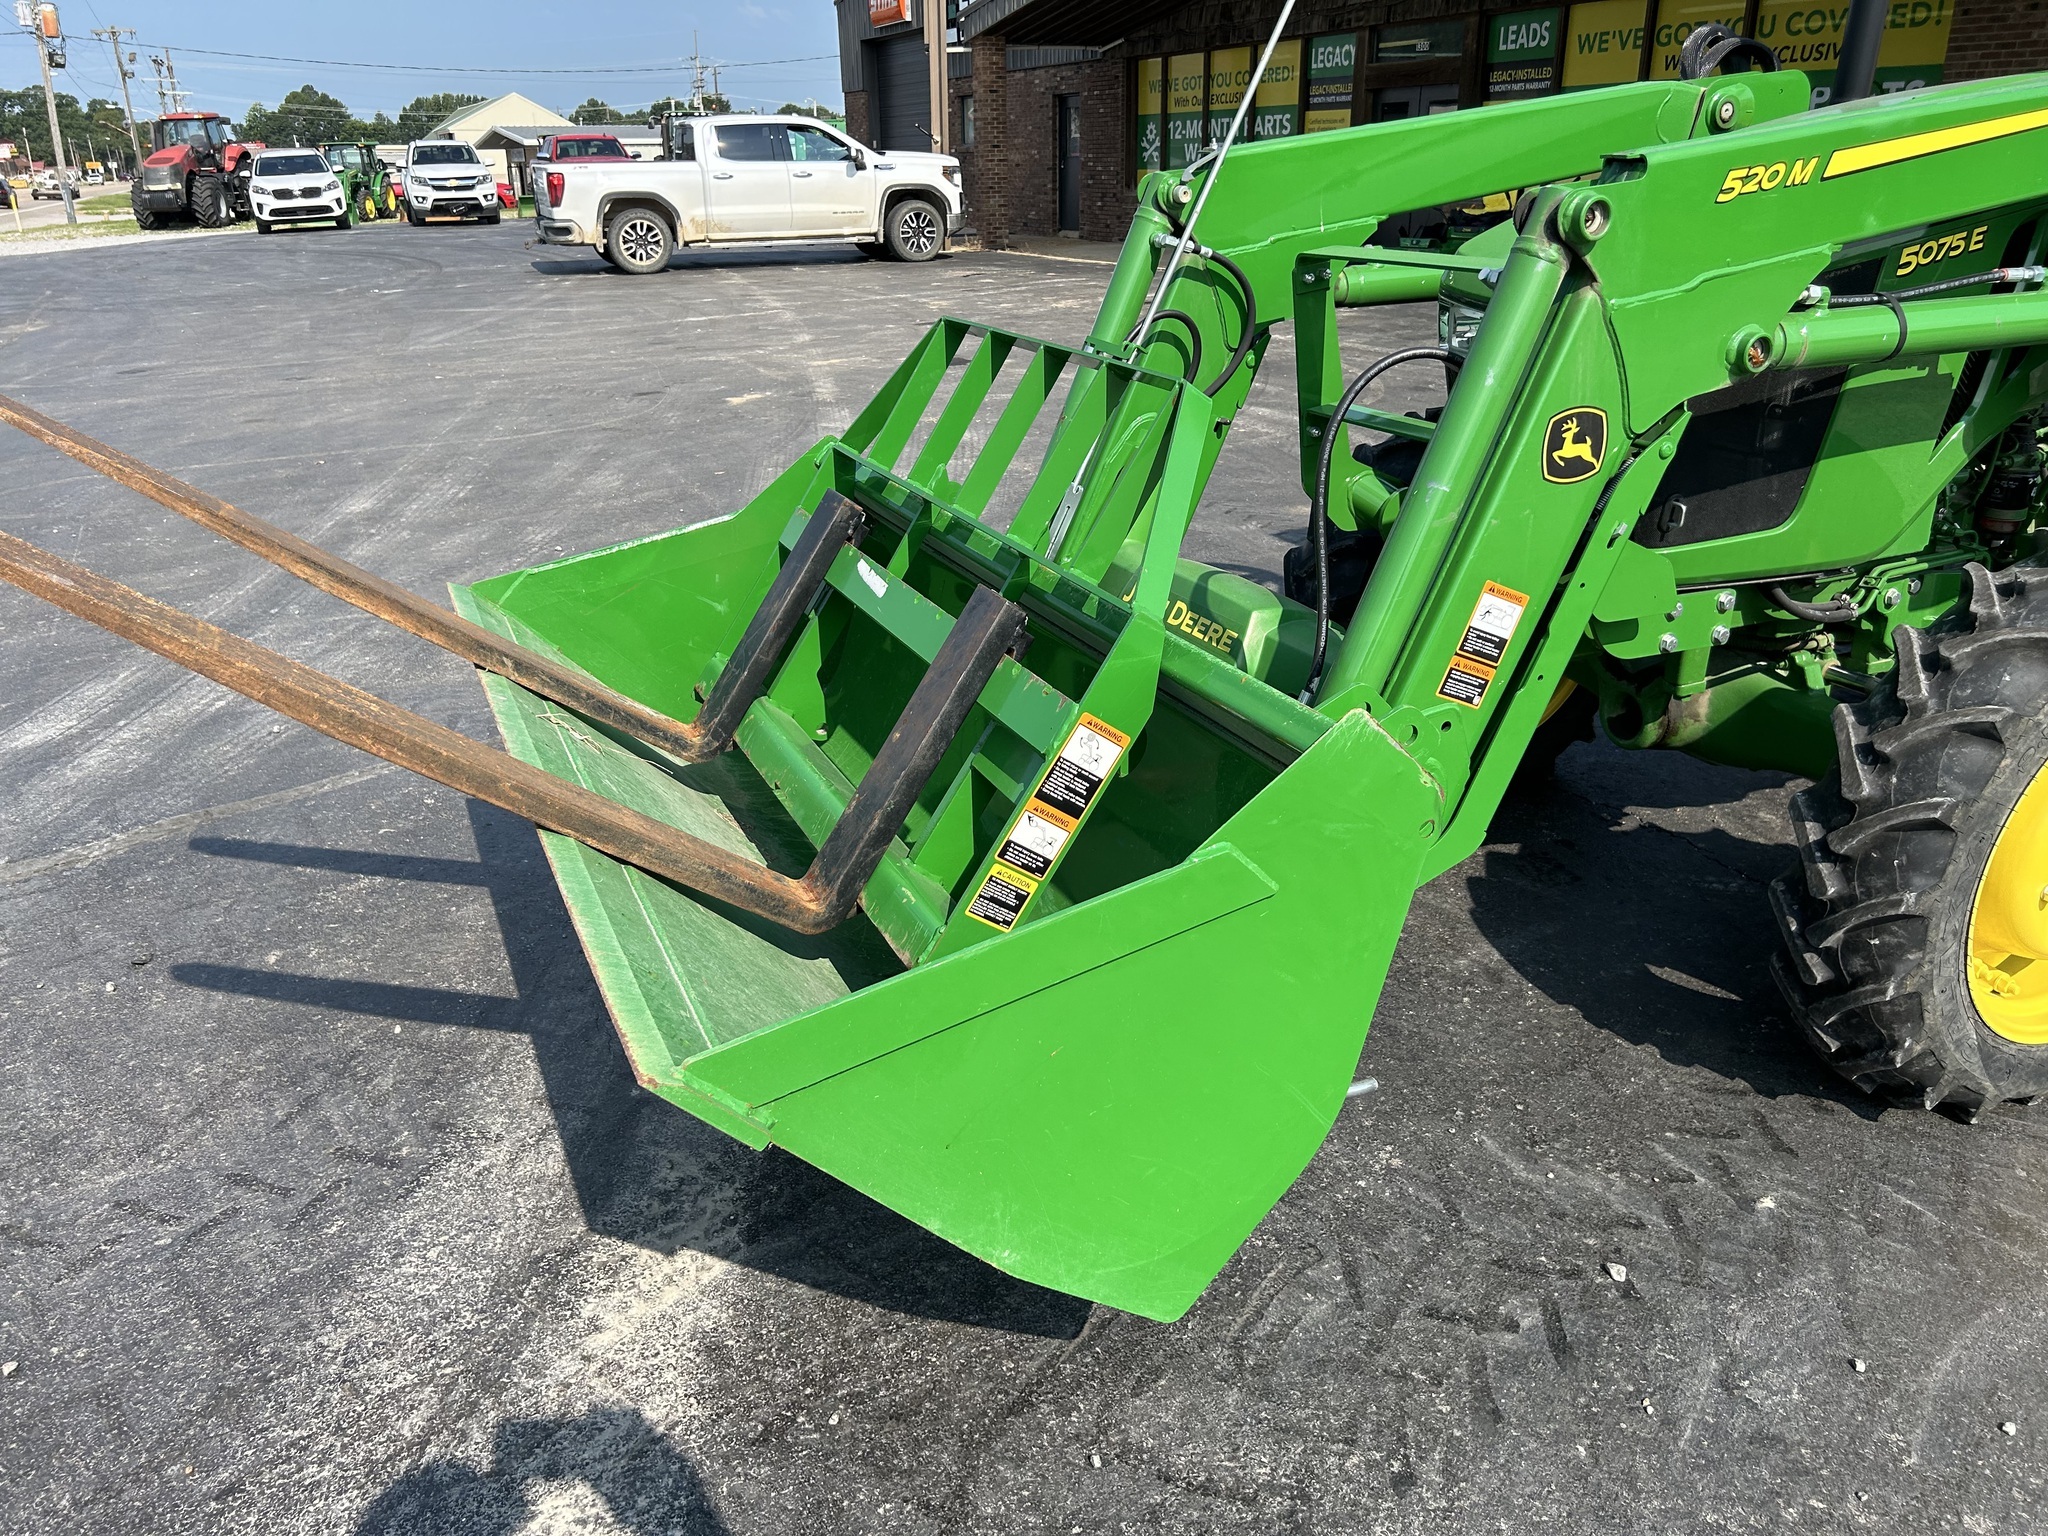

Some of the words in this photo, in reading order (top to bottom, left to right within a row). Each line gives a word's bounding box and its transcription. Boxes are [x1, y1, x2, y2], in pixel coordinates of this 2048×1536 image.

[1499, 20, 1551, 51] LEADS
[1184, 75, 1206, 94] GOT
[1210, 72, 1232, 91] YOU
[1489, 67, 1552, 82] LEGACY-INSTALLED
[1526, 80, 1552, 90] WARRANTY
[1174, 96, 1190, 108] With
[1495, 588, 1524, 604] WARNING
[1166, 599, 1239, 654] DEERE
[1462, 662, 1490, 677] WARNING
[1092, 719, 1123, 744] WARNING
[1037, 807, 1071, 829] WARNING
[1001, 870, 1032, 890] CAUTION
